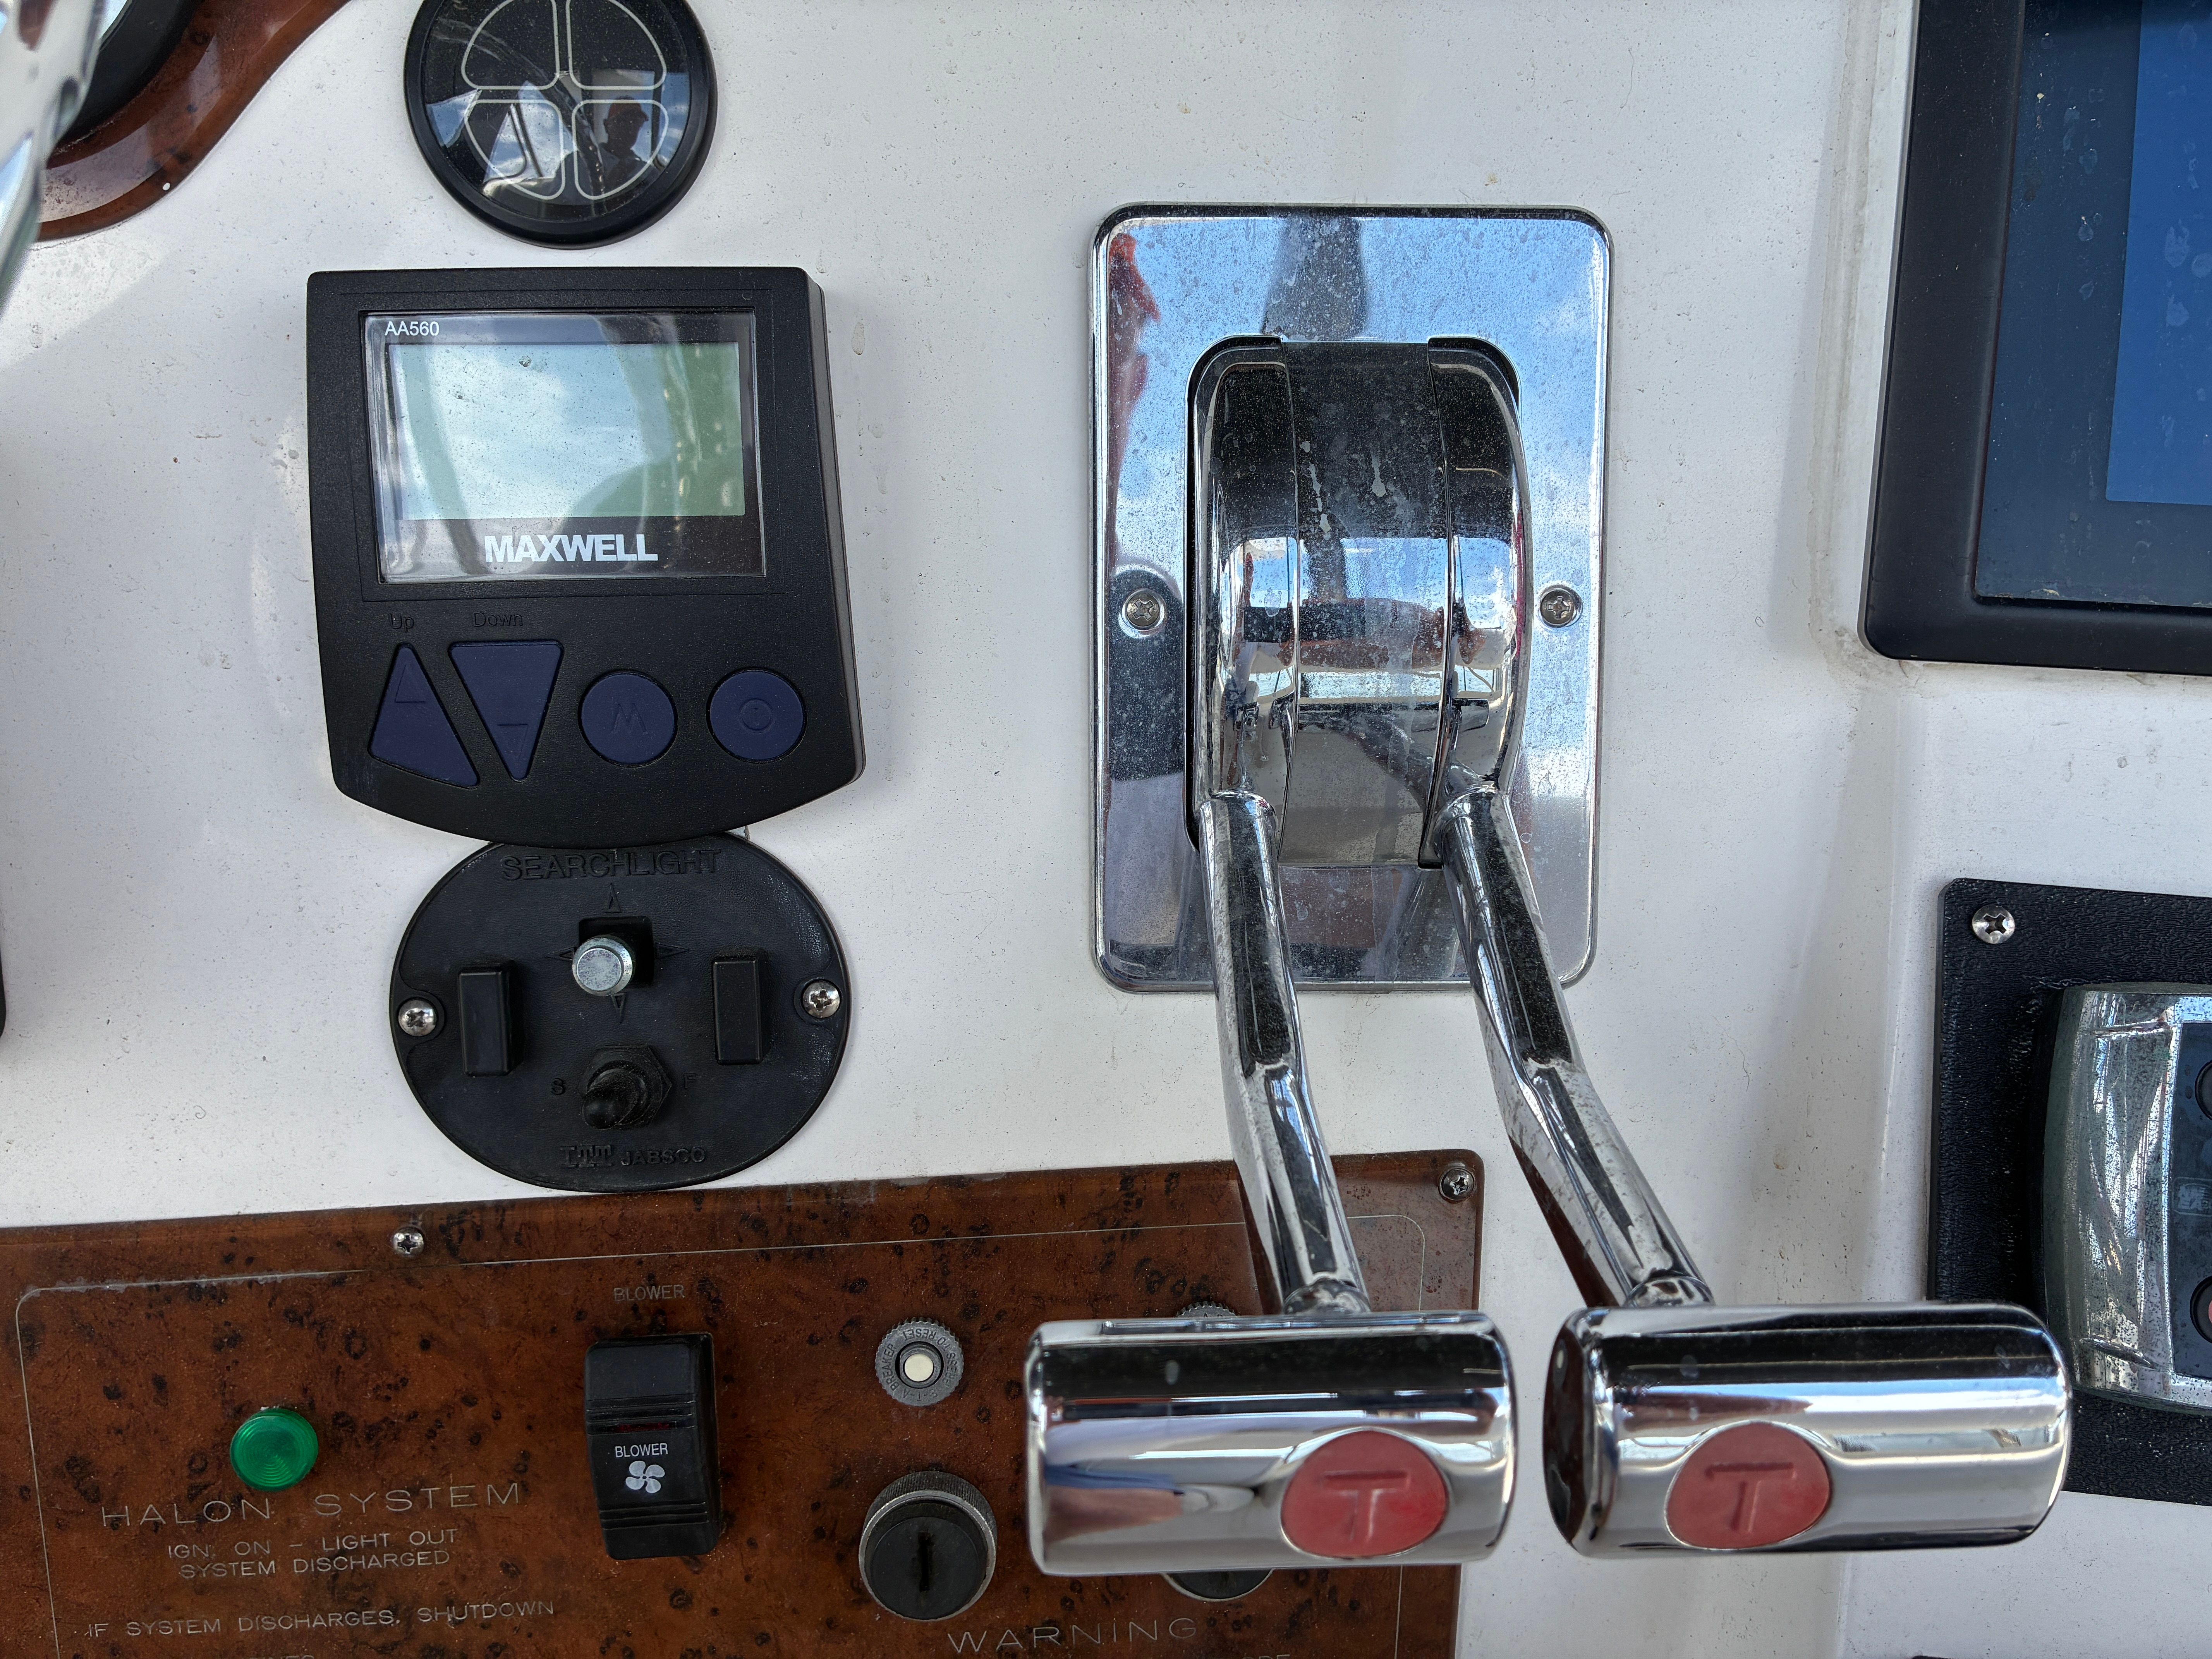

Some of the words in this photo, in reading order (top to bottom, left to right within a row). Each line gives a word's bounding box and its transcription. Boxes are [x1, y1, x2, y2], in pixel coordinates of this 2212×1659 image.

[385, 321, 439, 336] AA560
[484, 534, 658, 562] MAXWELL
[387, 613, 415, 633] Up
[472, 611, 524, 628] Down
[500, 849, 721, 880] SEARCHLIGHT
[551, 1077, 566, 1095] S
[683, 1073, 697, 1089] F
[620, 1147, 706, 1166] JABSCO
[613, 1284, 685, 1301] BLOWER
[902, 1328, 937, 1341] RESET
[937, 1336, 951, 1352] TO
[882, 1343, 899, 1391] BREAKER
[615, 1443, 668, 1458] BLOWER
[101, 1498, 270, 1527] HALON
[314, 1482, 519, 1516] SYSTEM
[234, 1540, 271, 1556] ON
[322, 1532, 390, 1551] LIGHT
[409, 1528, 459, 1546] OUT
[180, 1560, 276, 1580] SYSTEM
[293, 1550, 450, 1574] DISCHARGED
[88, 1622, 110, 1638] IF
[126, 1618, 221, 1637] SYSTEM
[417, 1600, 554, 1623] SHUTDOWN
[947, 1618, 1196, 1653] WARNING
